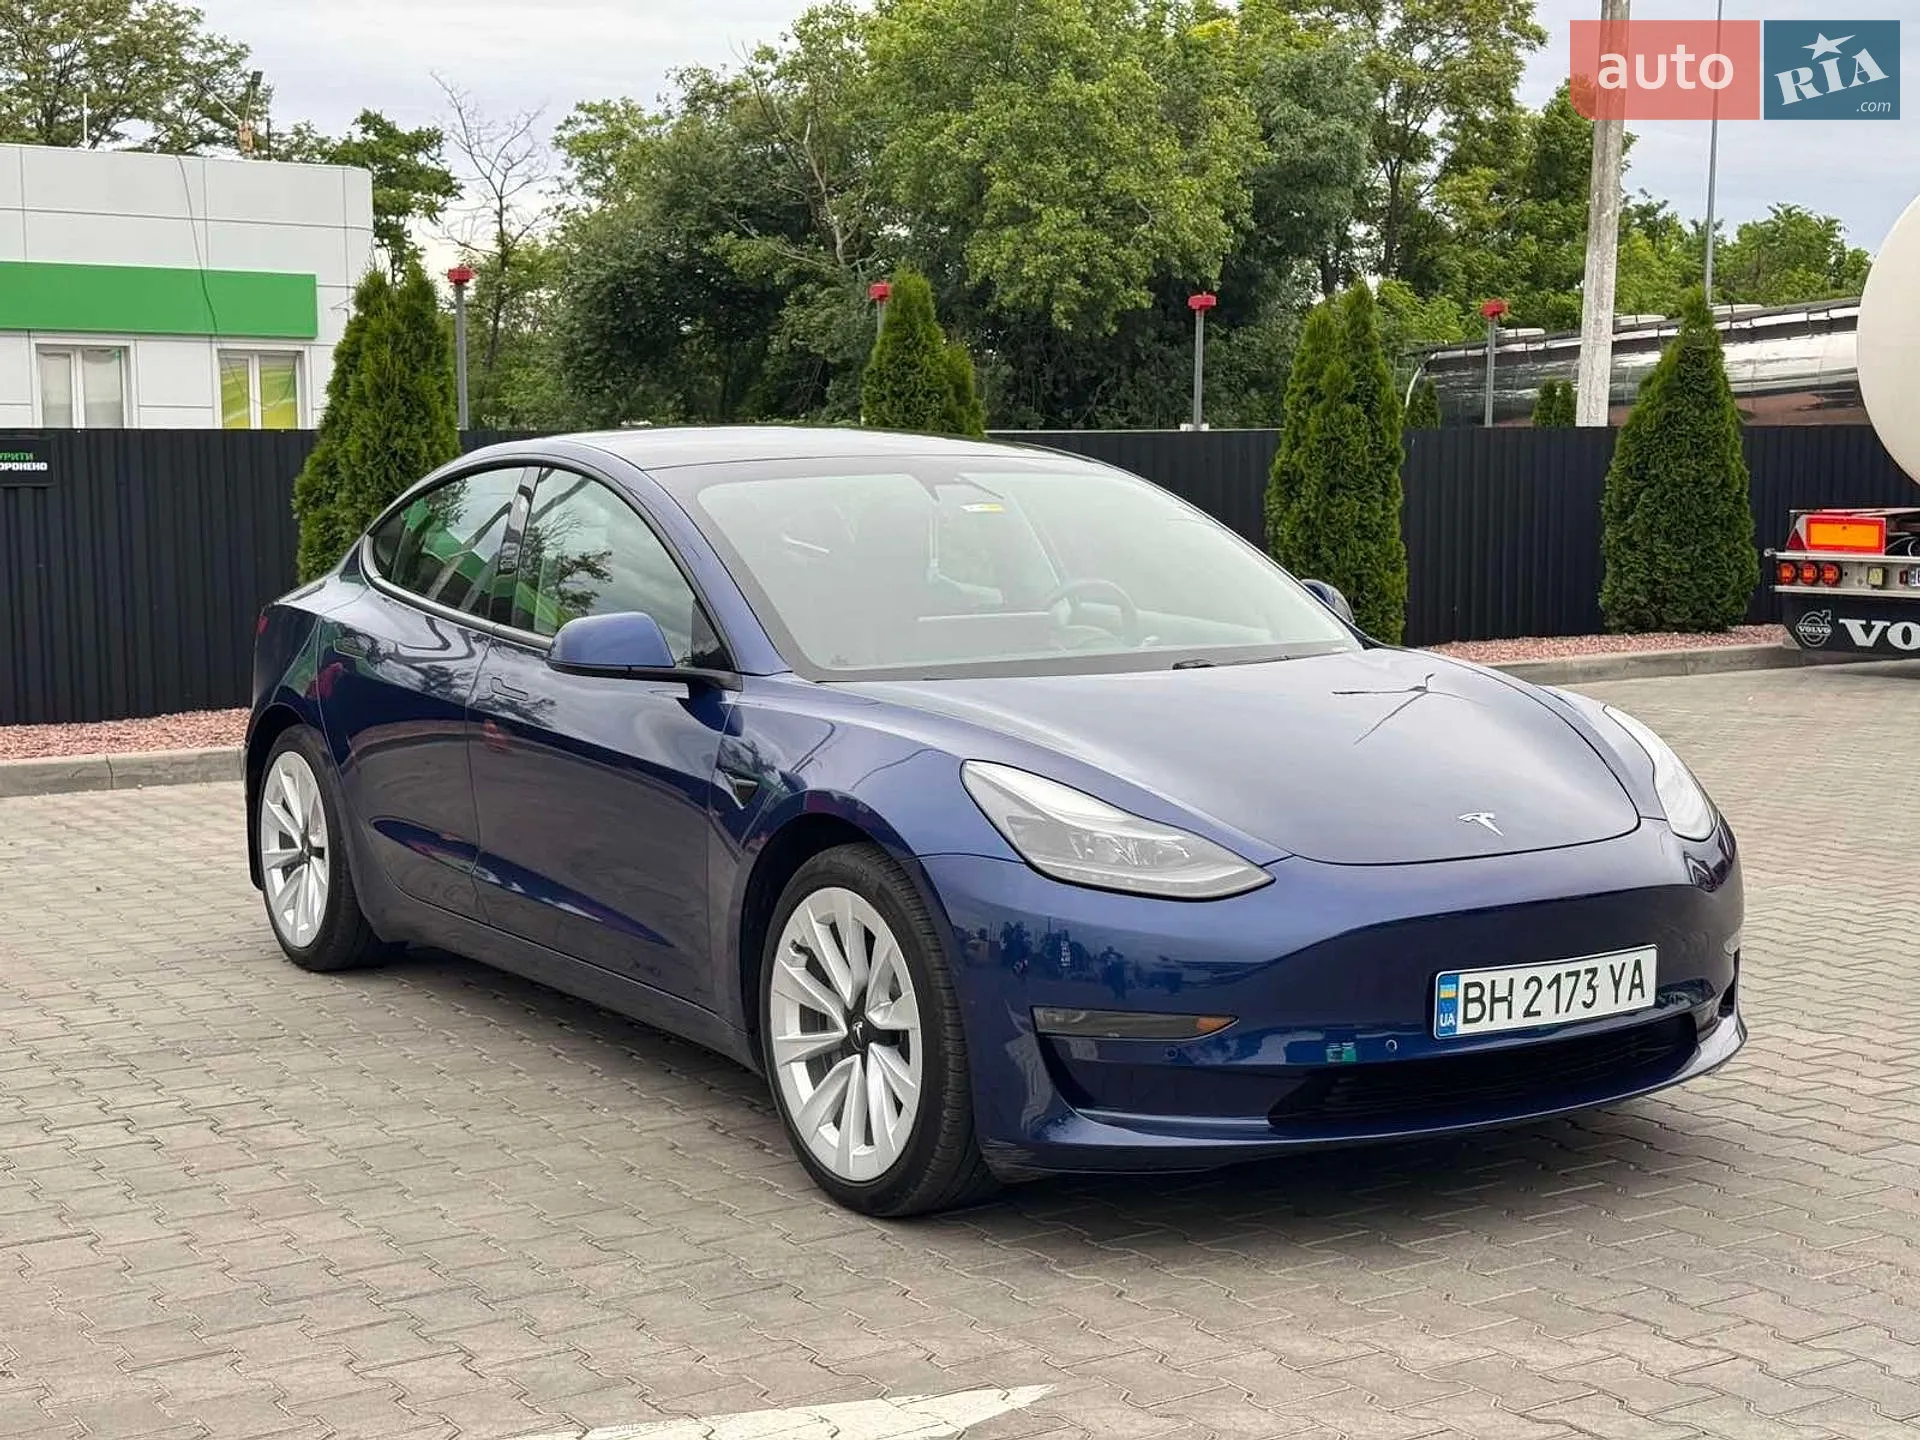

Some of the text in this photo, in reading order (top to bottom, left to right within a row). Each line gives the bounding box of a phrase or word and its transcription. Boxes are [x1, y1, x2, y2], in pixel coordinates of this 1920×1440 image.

[1799, 626, 1831, 634] VOLVO
[1463, 958, 1646, 1025] BH 2173 YA
[1439, 1014, 1456, 1027] UA
